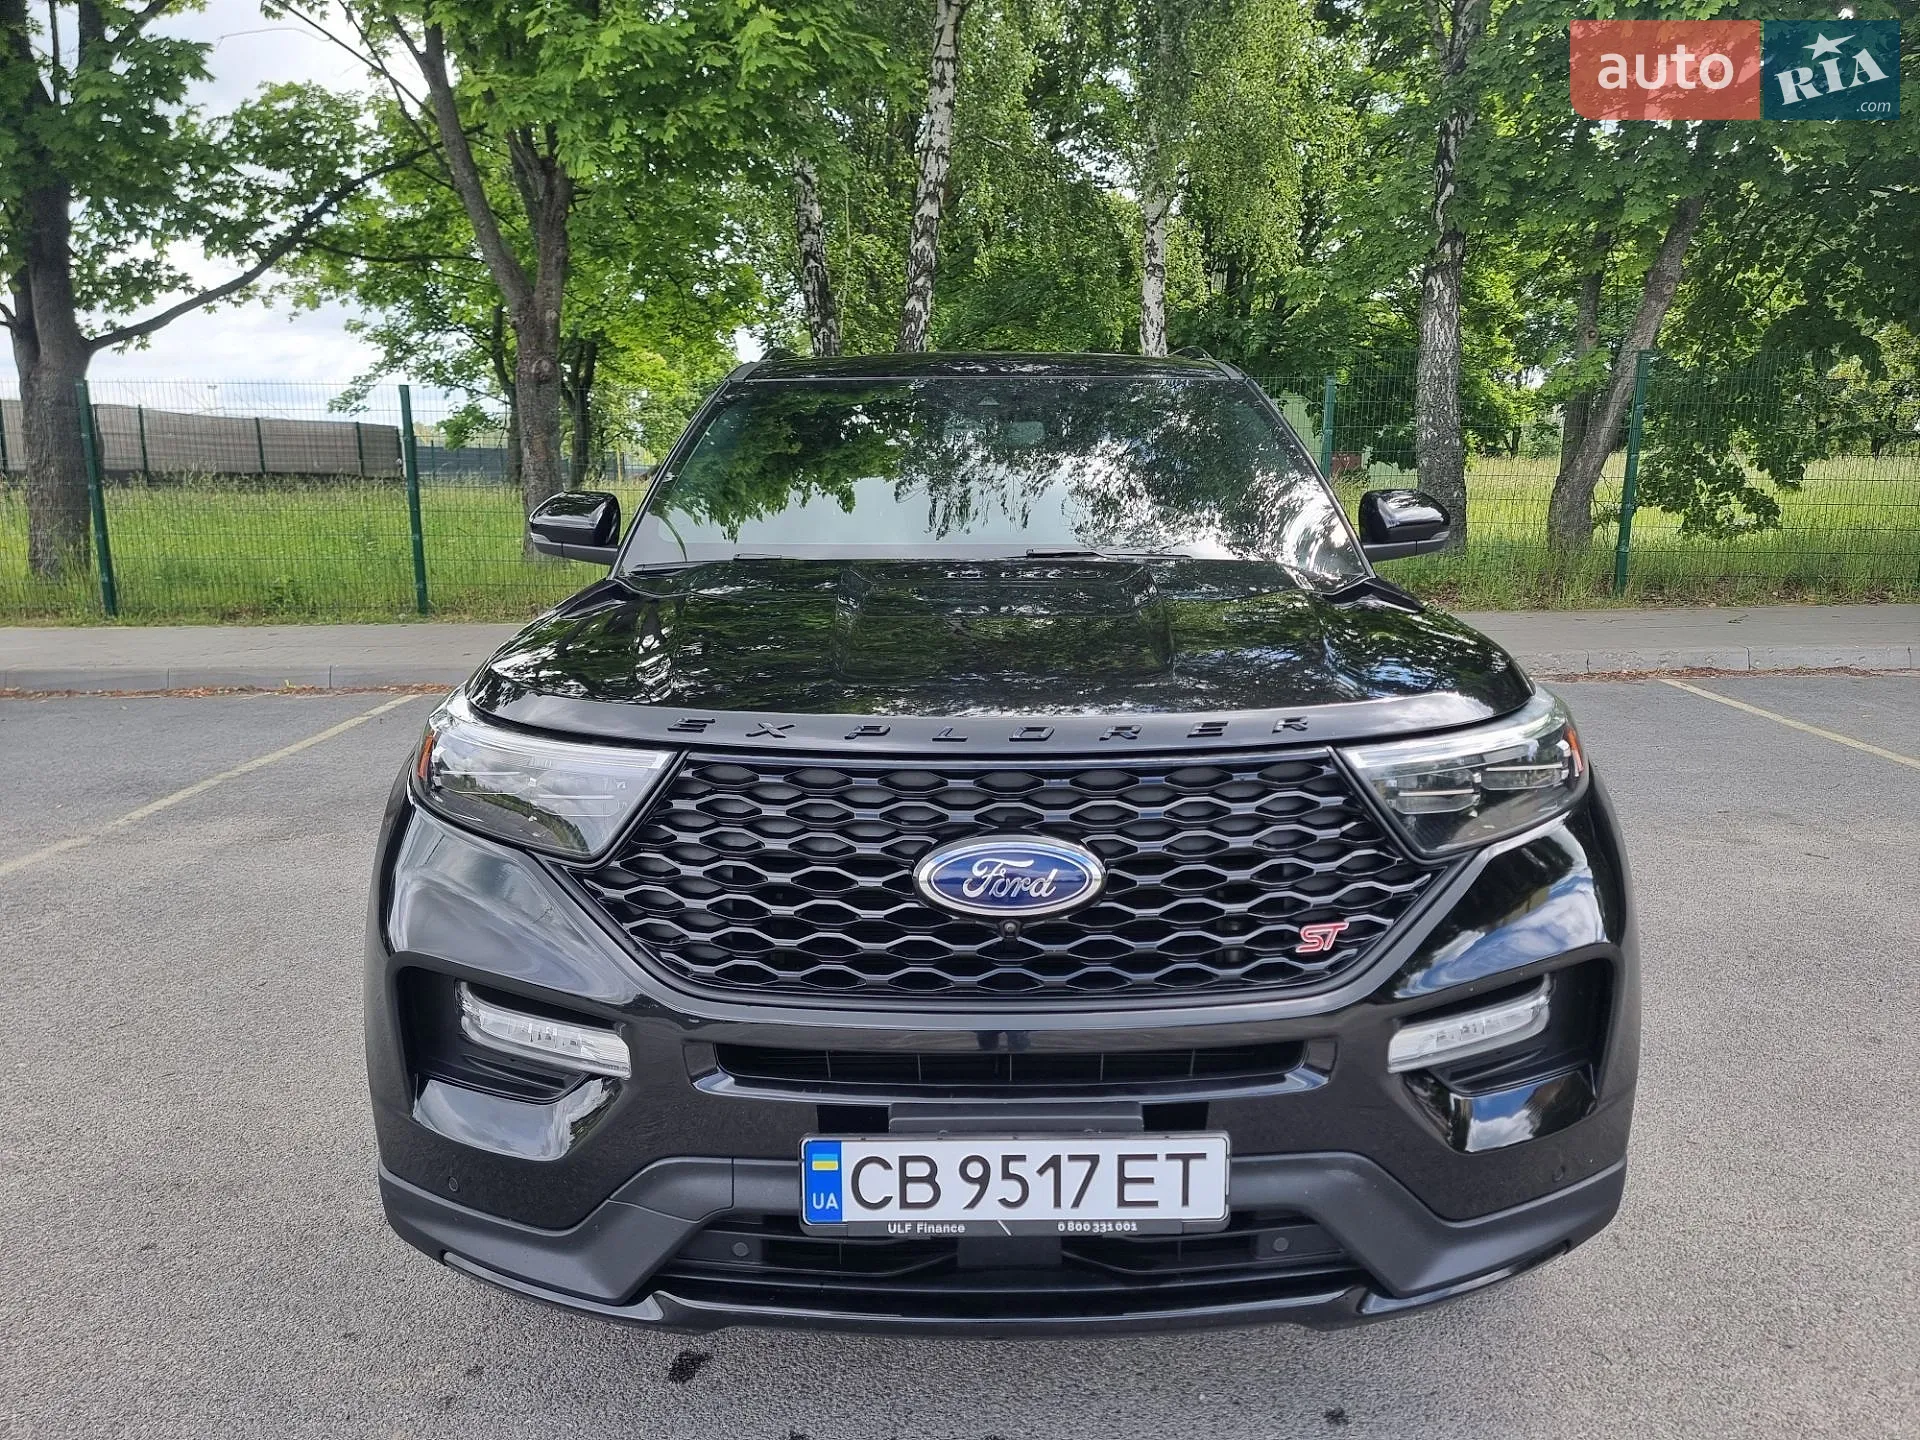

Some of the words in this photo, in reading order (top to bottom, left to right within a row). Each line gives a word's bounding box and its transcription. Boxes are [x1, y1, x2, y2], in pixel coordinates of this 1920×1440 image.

[666, 715, 1311, 743] EXPLORER
[962, 858, 1057, 899] Ford
[1296, 922, 1349, 953] ST
[850, 1155, 942, 1210] CB
[958, 1154, 1101, 1210] 9517
[1116, 1153, 1207, 1209] ET
[812, 1193, 839, 1210] UA
[887, 1223, 912, 1234] ULF
[916, 1222, 966, 1235] Finance
